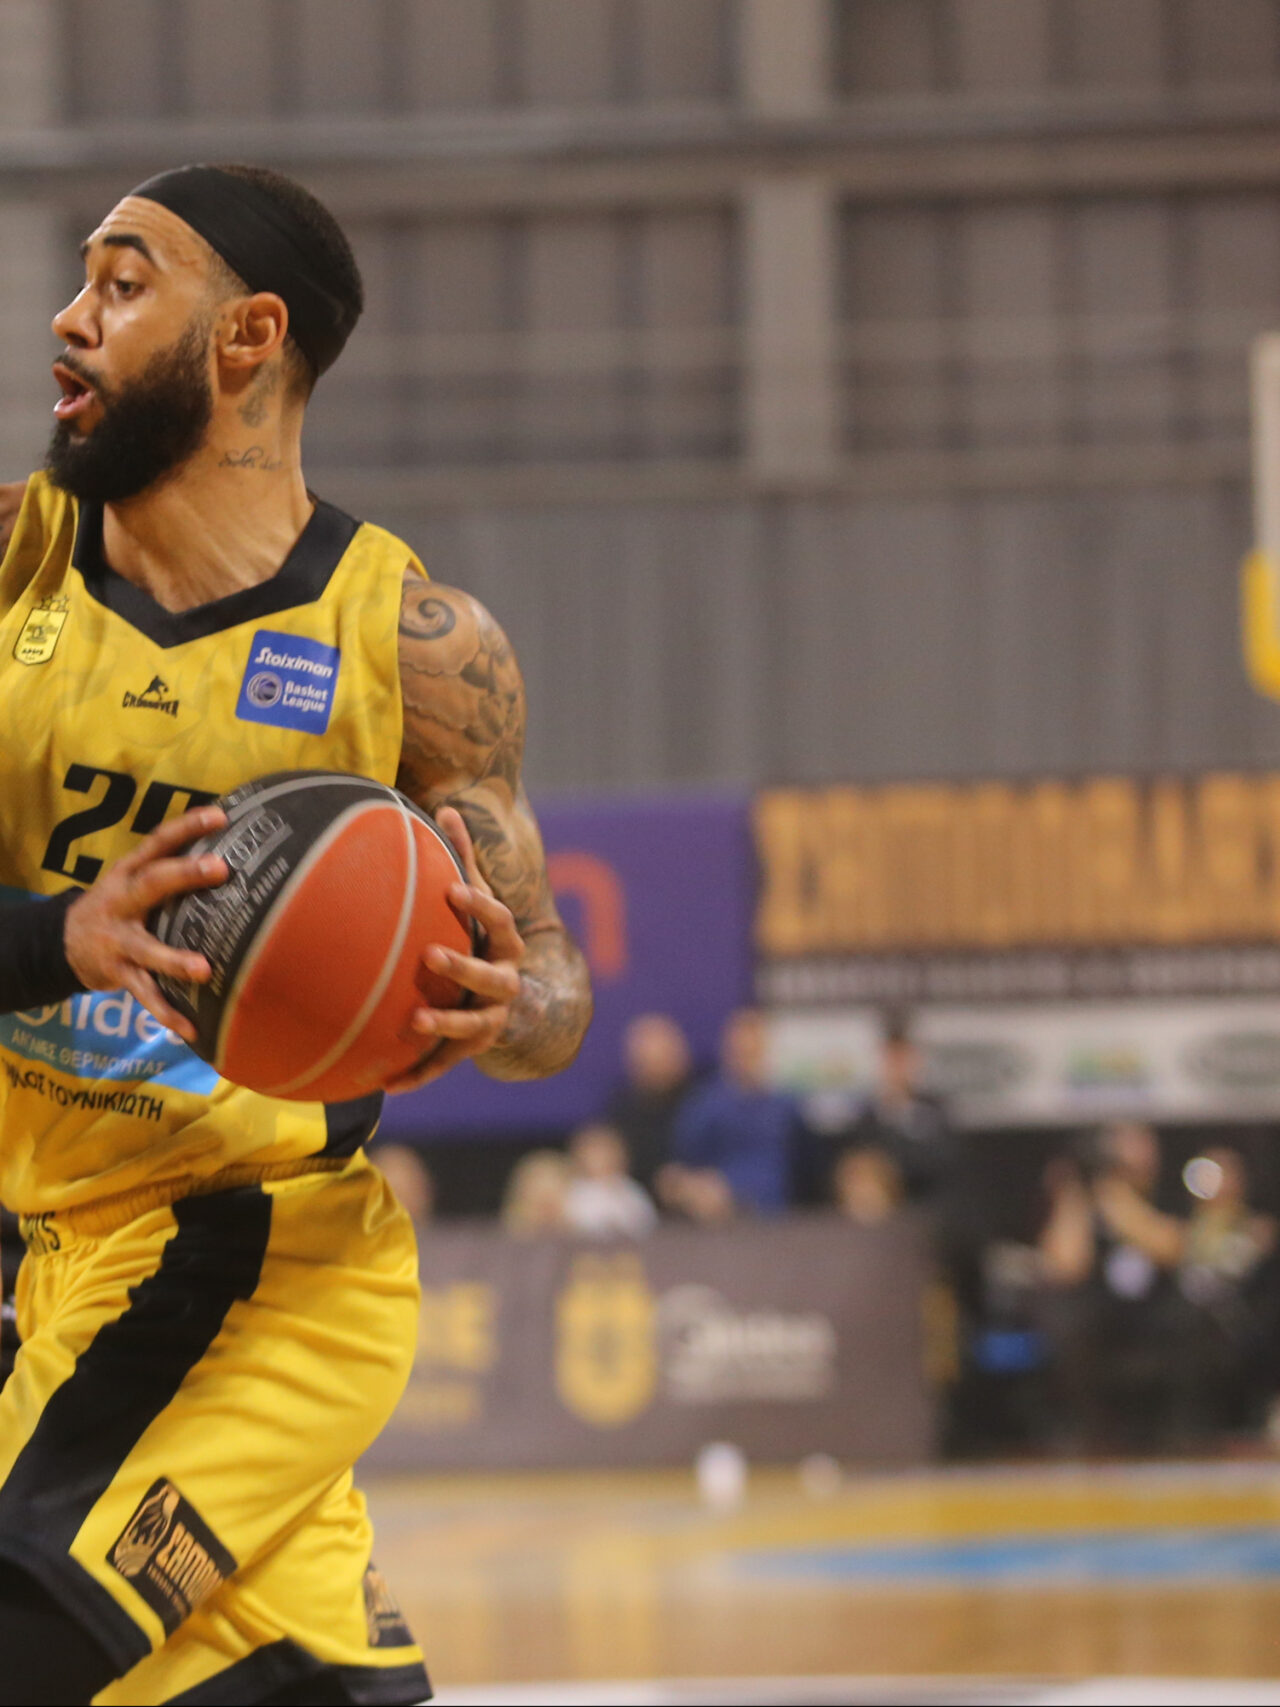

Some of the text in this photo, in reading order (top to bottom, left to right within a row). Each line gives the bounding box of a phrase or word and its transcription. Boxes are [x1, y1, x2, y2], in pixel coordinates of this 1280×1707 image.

[255, 647, 333, 678] Stoiximan
[285, 681, 328, 701] Basket
[282, 694, 326, 712] League
